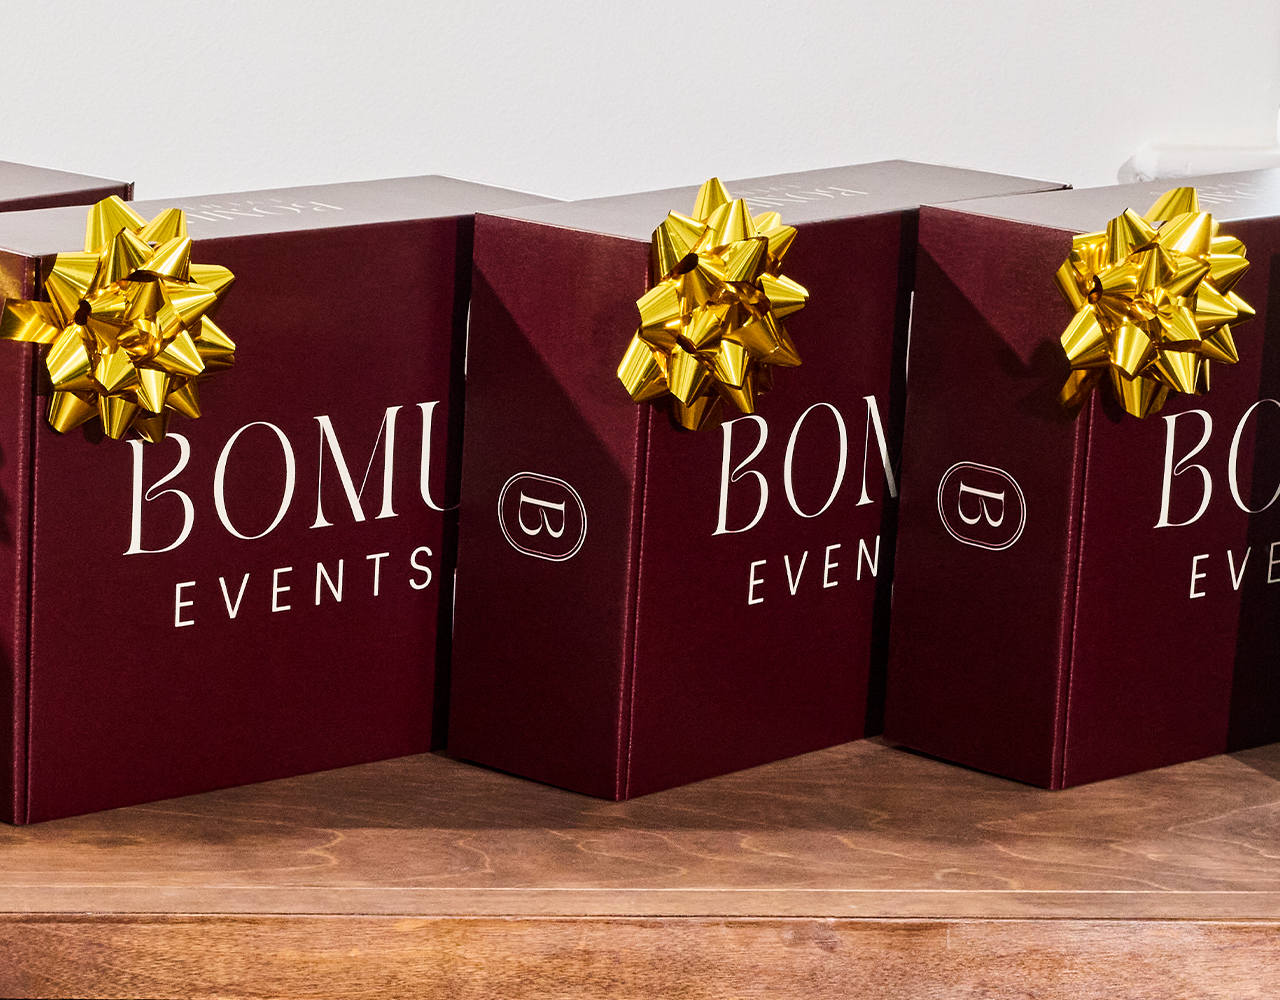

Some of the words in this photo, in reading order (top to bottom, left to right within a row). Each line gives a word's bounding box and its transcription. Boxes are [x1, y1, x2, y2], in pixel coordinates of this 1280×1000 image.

[1153, 399, 1280, 529] BO
[519, 490, 567, 540] B
[958, 480, 1005, 529] B
[174, 546, 433, 628] EVENTS
[747, 535, 881, 605] EVEN
[1190, 541, 1280, 599] EVE
